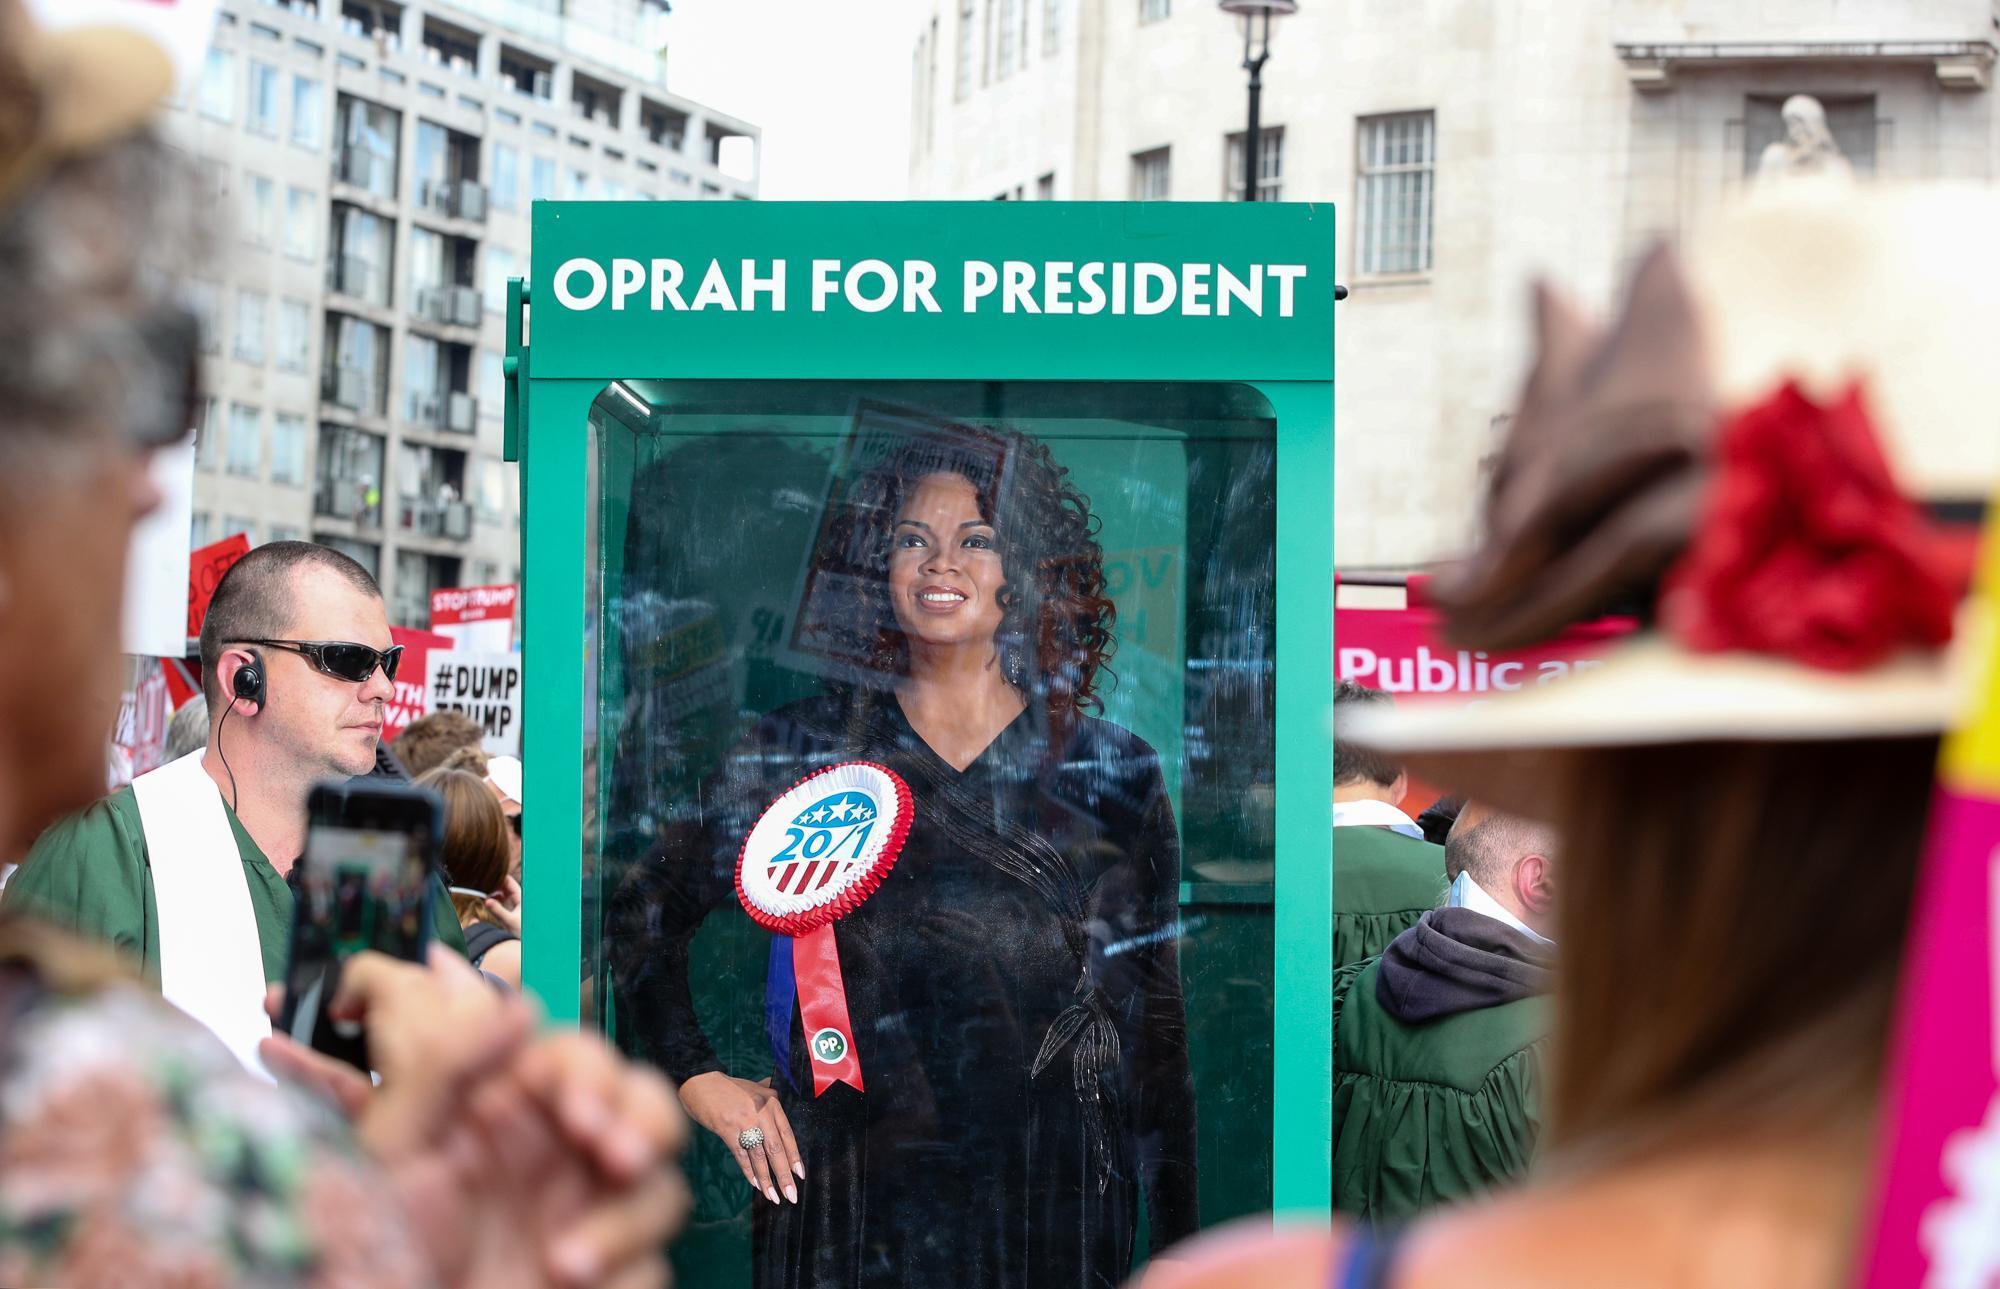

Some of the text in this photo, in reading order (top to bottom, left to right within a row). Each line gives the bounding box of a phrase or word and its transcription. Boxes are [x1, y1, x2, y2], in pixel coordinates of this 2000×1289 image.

[554, 258, 1306, 316] OPRAH FOR PRESIDENT
[434, 663, 518, 700] #DUMP
[1338, 646, 1525, 692] Public
[770, 820, 874, 863] 20/1
